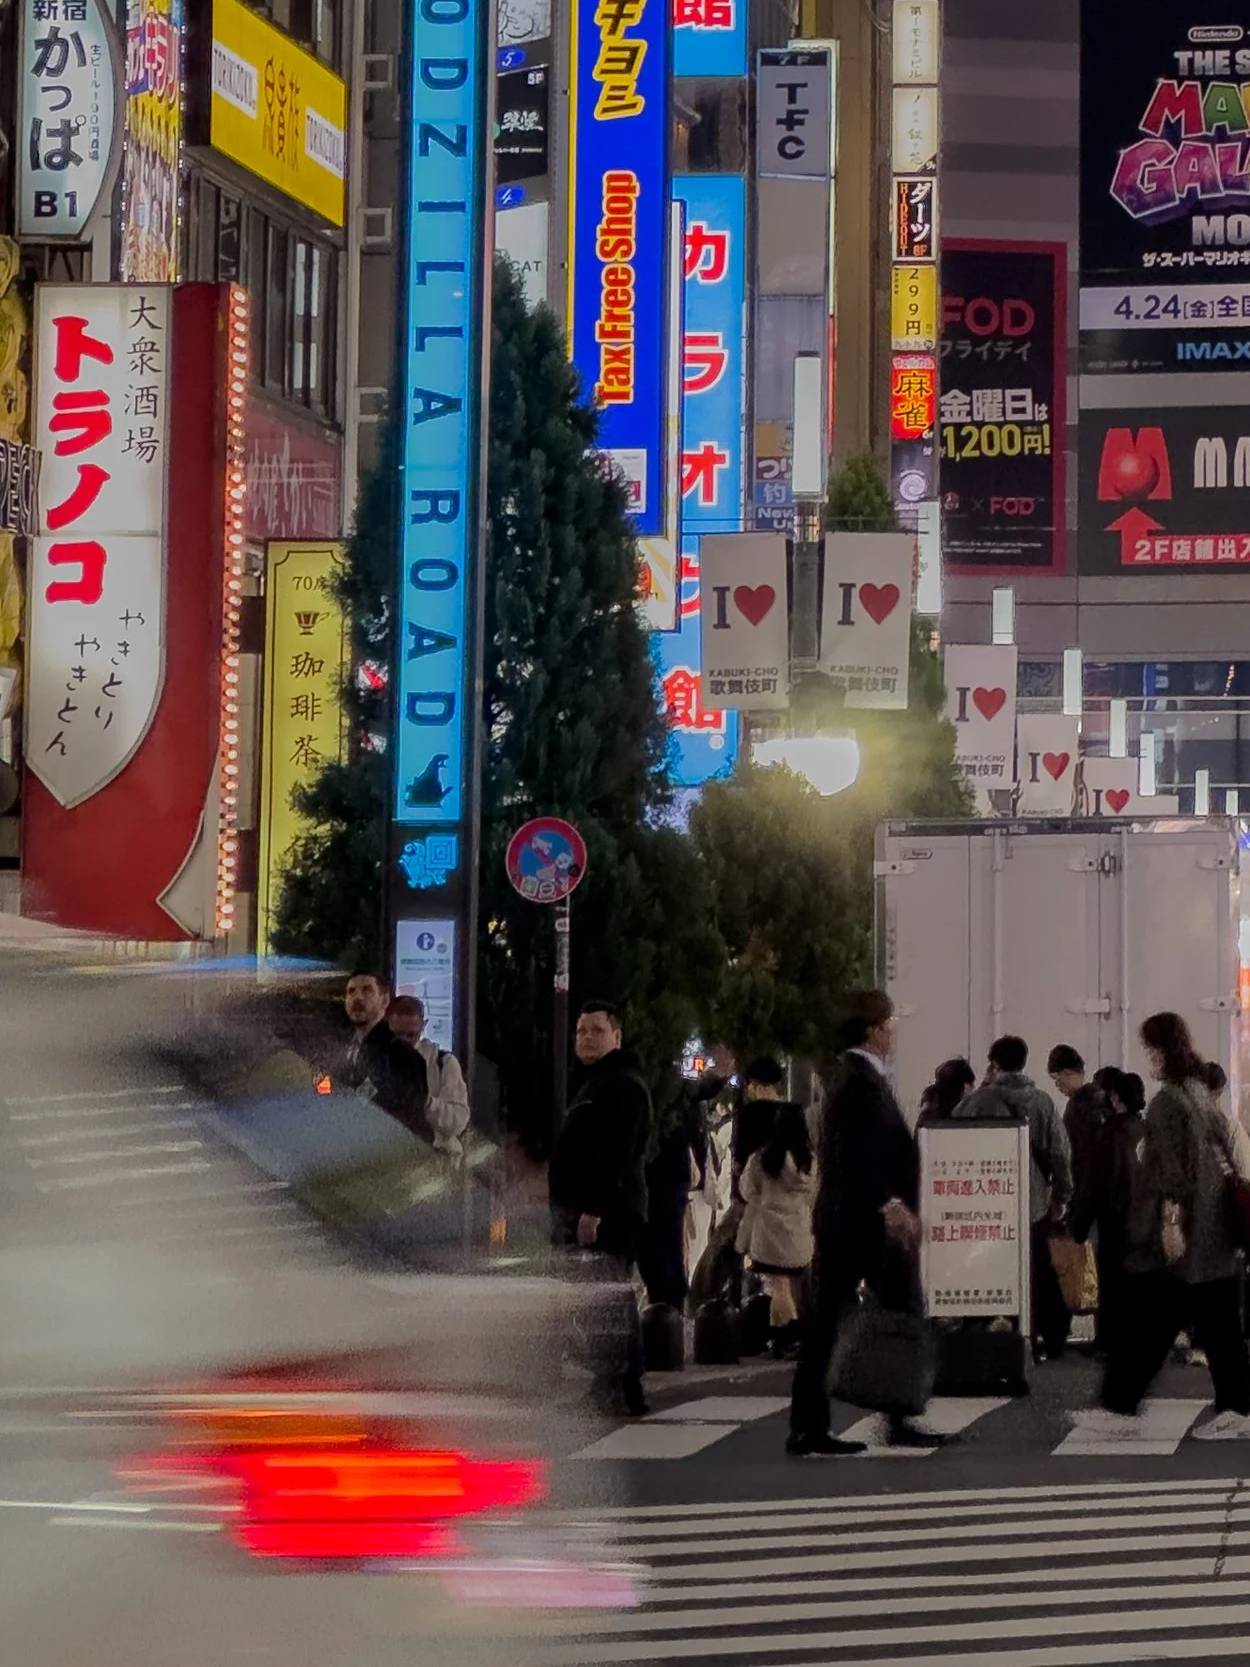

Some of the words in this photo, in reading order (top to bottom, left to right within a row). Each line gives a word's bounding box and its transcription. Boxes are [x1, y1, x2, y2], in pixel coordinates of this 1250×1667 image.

[33, 0, 88, 21] 新宿
[1174, 50, 1231, 76] THE
[30, 26, 87, 171] かっぱ
[33, 190, 78, 218] B1
[598, 170, 640, 258] Shop
[910, 182, 932, 242] ダーツ
[598, 265, 636, 343] Free
[905, 268, 921, 335] 299円
[940, 296, 1036, 337] FOD
[123, 295, 162, 464] 大衆酒場
[599, 344, 637, 408] Tax
[893, 370, 933, 432] 麻雀
[939, 387, 1049, 424] 金曜日は
[45, 315, 114, 606] トラノコ
[990, 497, 1035, 516] FOD
[405, 490, 460, 727] ROAD
[713, 585, 731, 629] I
[837, 583, 856, 626] I
[95, 608, 146, 730] やきとり
[709, 667, 779, 678] KABUKI-CHO
[709, 679, 778, 695] 歌舞伎町
[45, 633, 102, 757] やきとん
[956, 687, 971, 722] I
[1028, 752, 1041, 783] I
[1093, 789, 1104, 817] I
